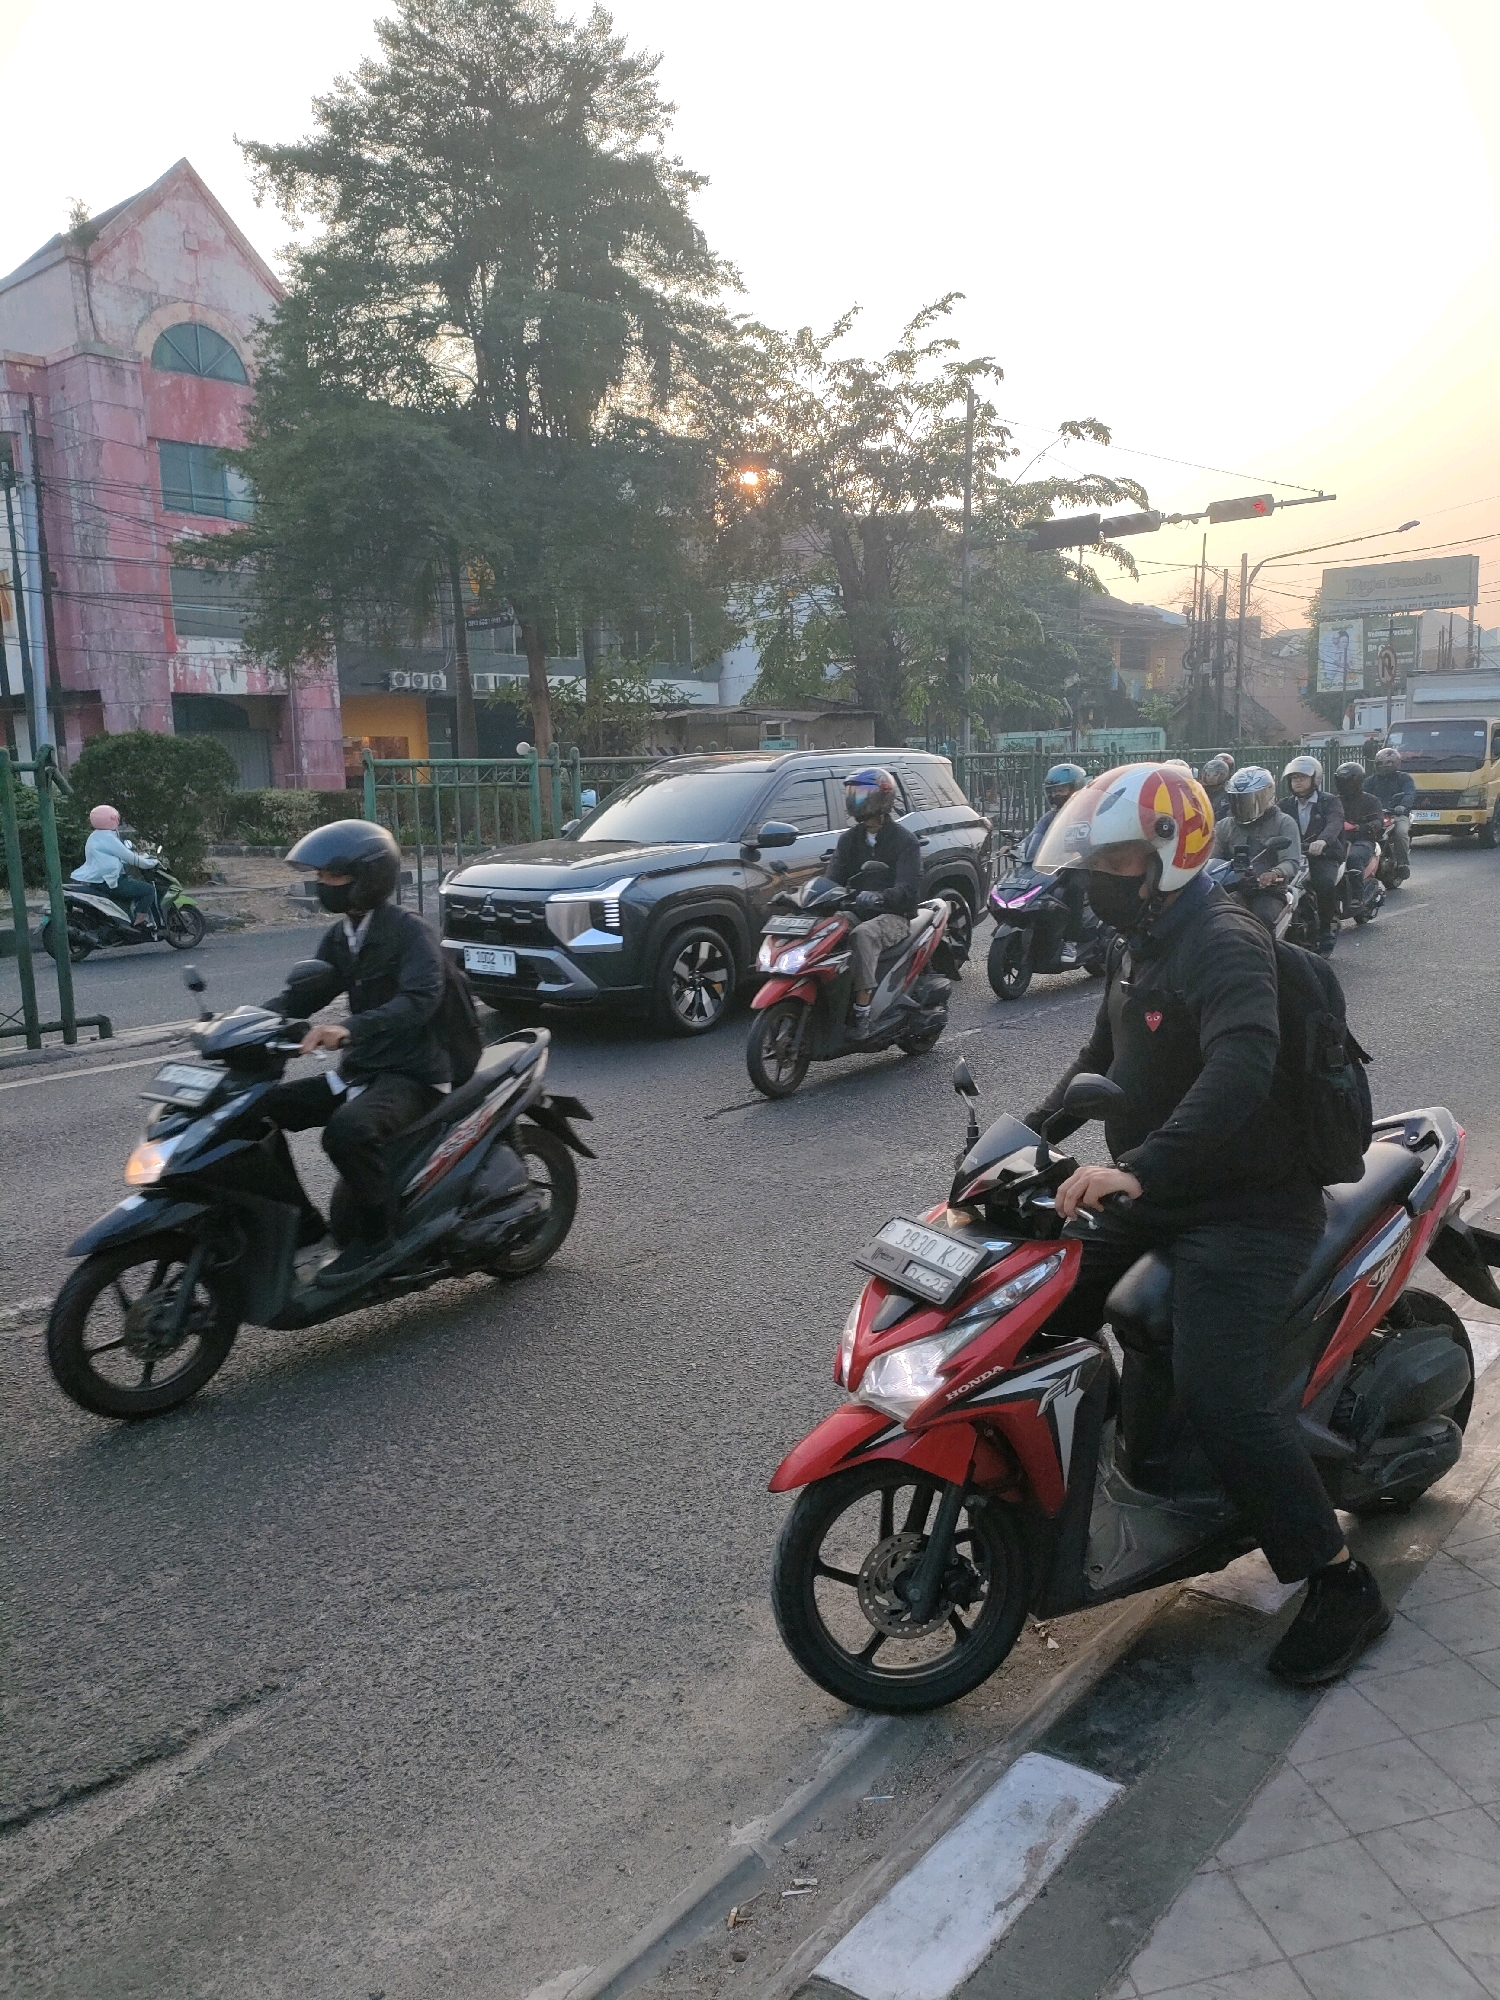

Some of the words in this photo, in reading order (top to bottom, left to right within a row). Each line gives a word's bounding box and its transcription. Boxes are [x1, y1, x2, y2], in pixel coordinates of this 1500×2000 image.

[1345, 577, 1386, 598] Raja
[1388, 573, 1443, 589] Sunda
[895, 1228, 938, 1257] 3930
[936, 1244, 976, 1272] KJU
[944, 1364, 1006, 1402] HONDA
